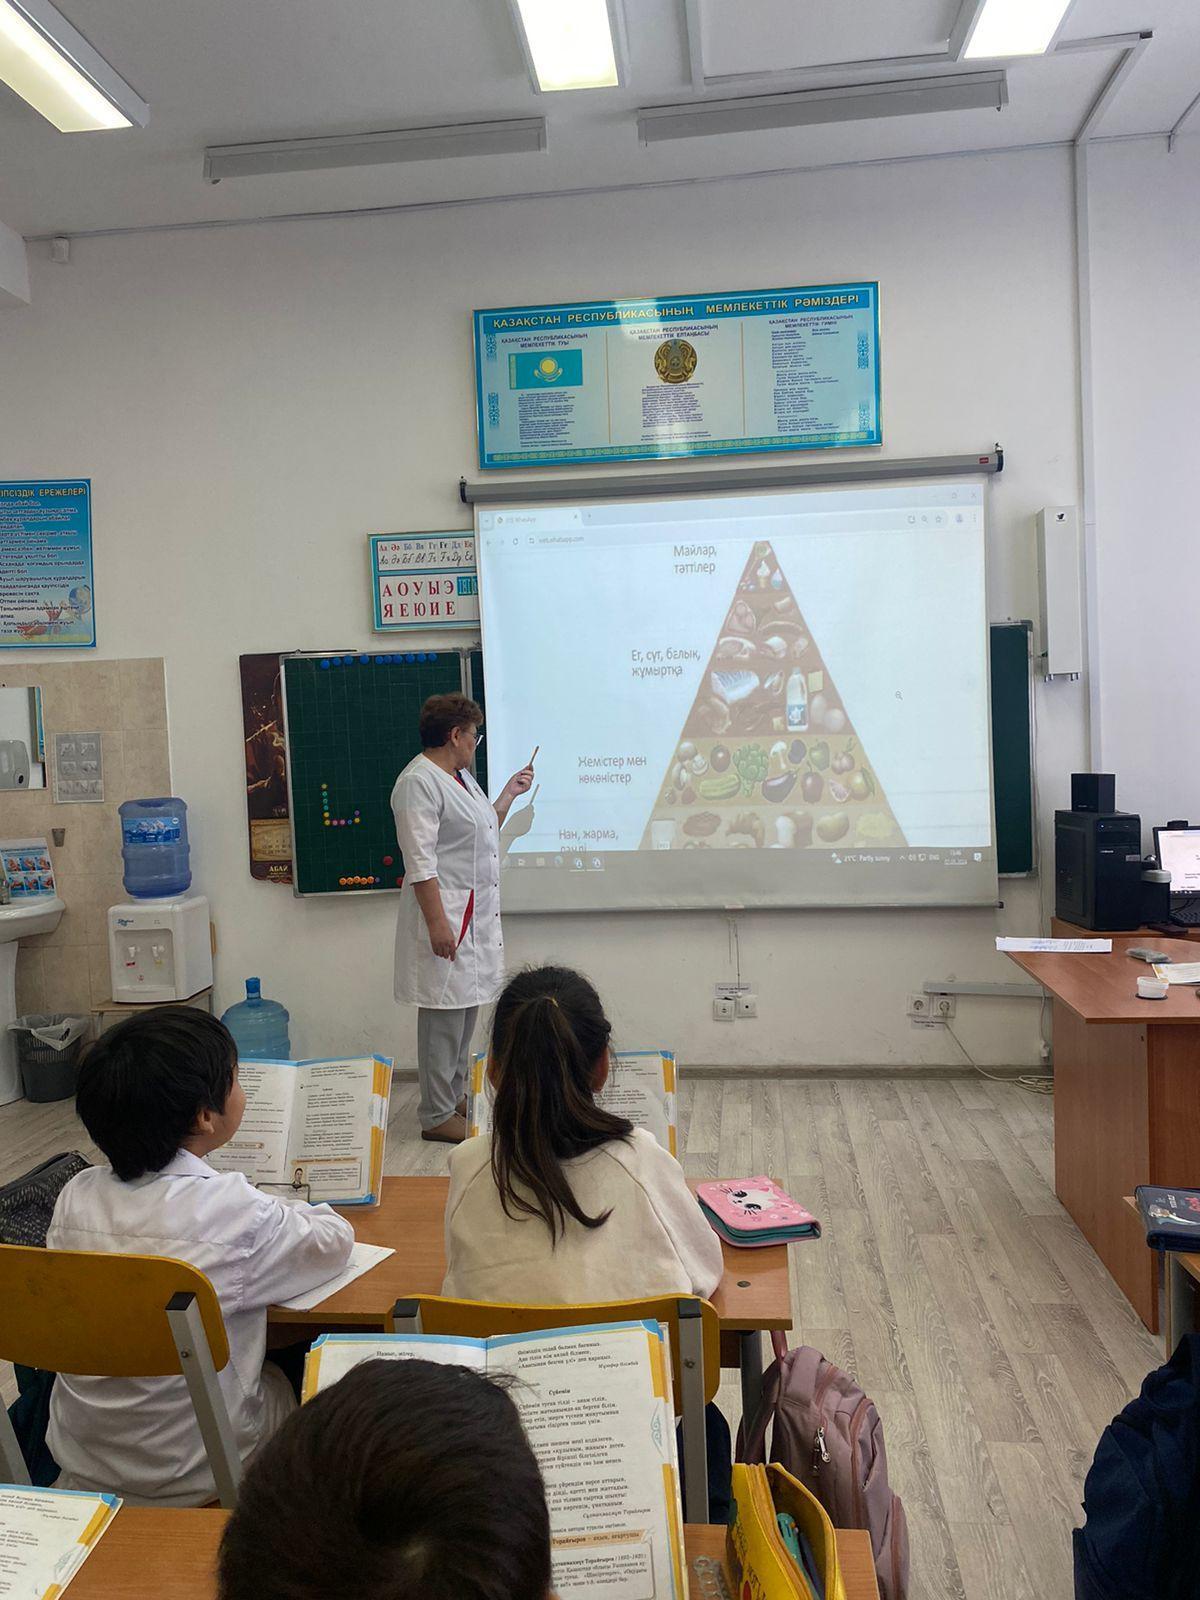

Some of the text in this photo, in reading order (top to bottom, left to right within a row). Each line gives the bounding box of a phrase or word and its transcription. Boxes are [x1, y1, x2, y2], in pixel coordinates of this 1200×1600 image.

[493, 294, 859, 328] ҚАЗАҚСТАН РЕСПУБЛИКАСЫНЫҢ МЕМЛЕКЕТТІК РӘМІЗДЕРІ
[39, 488, 86, 497] ЕРЕЖЕЛЕРІ
[673, 544, 717, 558] Майлар,
[674, 561, 716, 575] тәттілер
[382, 583, 392, 597] А
[397, 582, 409, 597] О
[412, 581, 423, 596] У
[428, 580, 440, 595] Ы
[444, 579, 454, 594] Э
[383, 604, 394, 618] Я
[414, 602, 426, 617] Ю
[578, 756, 647, 769] Жемістер мен
[578, 771, 632, 786] көкөністер
[559, 828, 619, 841] Нан, жарма,
